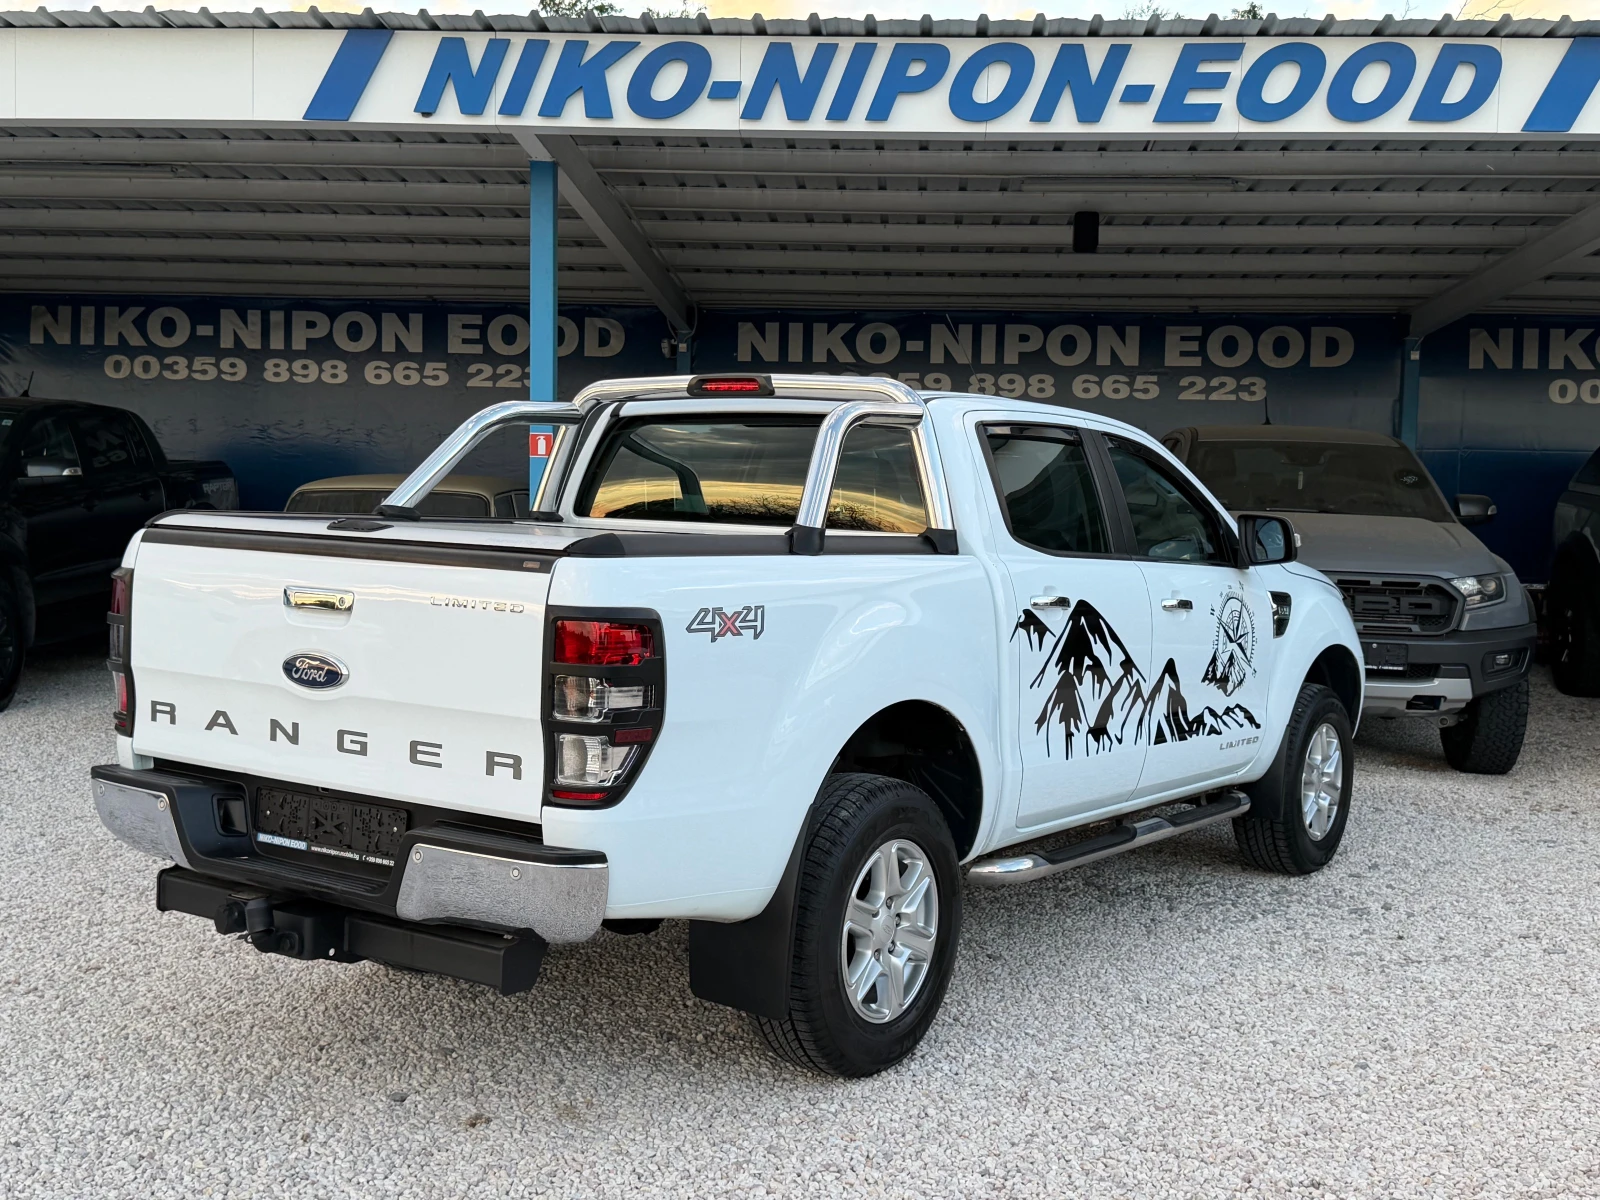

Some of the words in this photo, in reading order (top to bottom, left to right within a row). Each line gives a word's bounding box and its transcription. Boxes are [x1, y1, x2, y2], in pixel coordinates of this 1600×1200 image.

[413, 36, 1503, 123] NIKO-NIPON-EOOD
[29, 305, 423, 355] NIKO-NIPON
[737, 321, 1145, 367] NIKO-NIPON
[1163, 323, 1355, 368] EOOD
[1468, 327, 1600, 370] NIK
[103, 354, 248, 382] 00359
[263, 357, 348, 384] 898
[364, 360, 450, 387] 665
[466, 363, 531, 388] 22
[1071, 373, 1160, 400] 665
[1177, 375, 1267, 402] 223
[429, 596, 525, 614] LIMITED
[291, 657, 328, 683] Ford
[150, 699, 523, 781] RANGER
[1219, 735, 1260, 751] LIMITED
